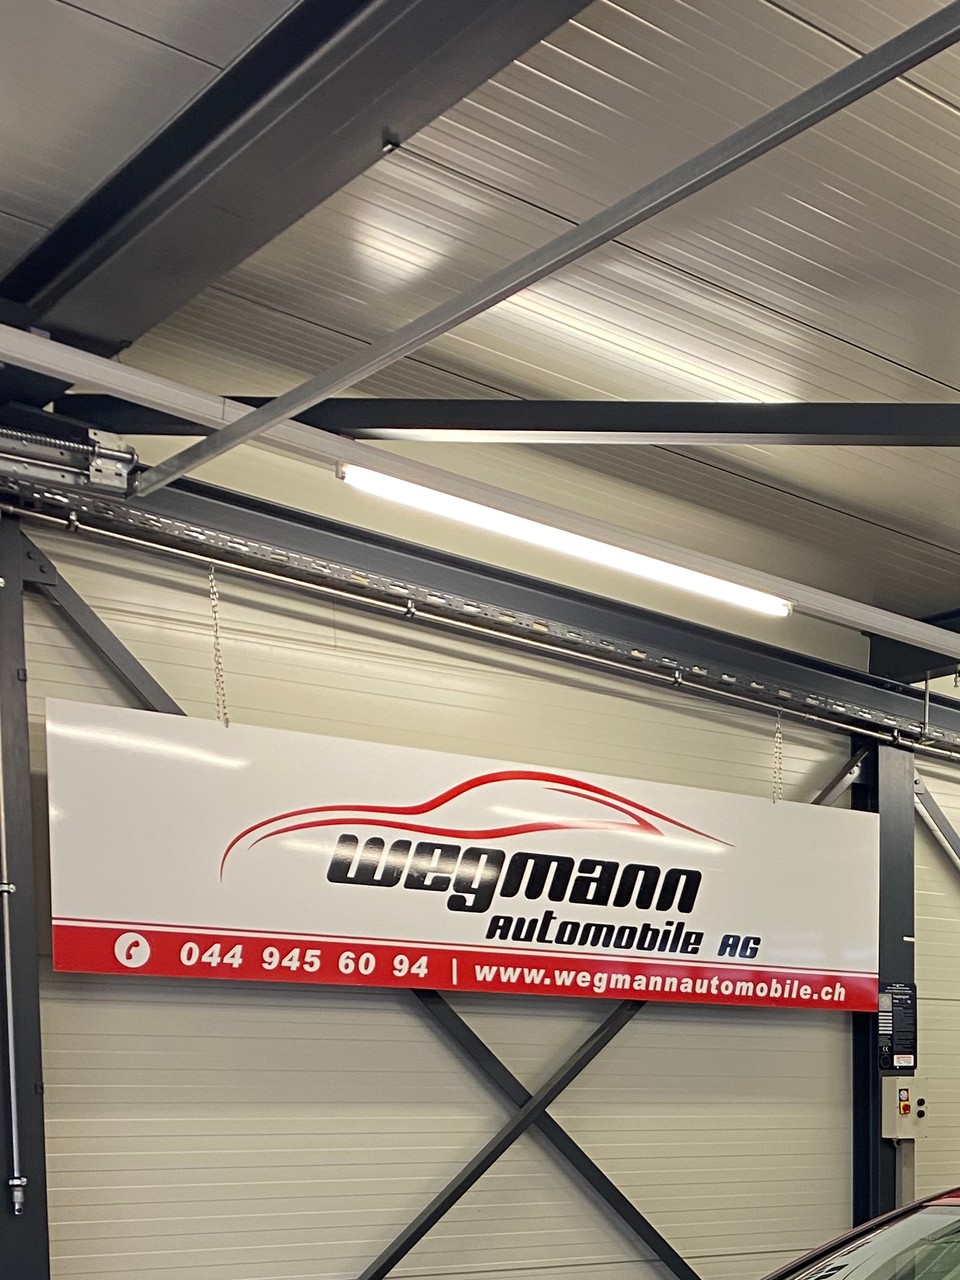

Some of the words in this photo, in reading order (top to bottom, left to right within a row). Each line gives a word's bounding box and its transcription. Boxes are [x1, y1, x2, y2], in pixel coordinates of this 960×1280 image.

[327, 833, 702, 914] wegmann
[179, 941, 243, 968] 044
[261, 946, 321, 973] 945
[338, 951, 376, 975] 60
[392, 954, 429, 978] 94
[474, 964, 846, 1002] www.wegmannautomobile.ch
[717, 934, 761, 959] AG
